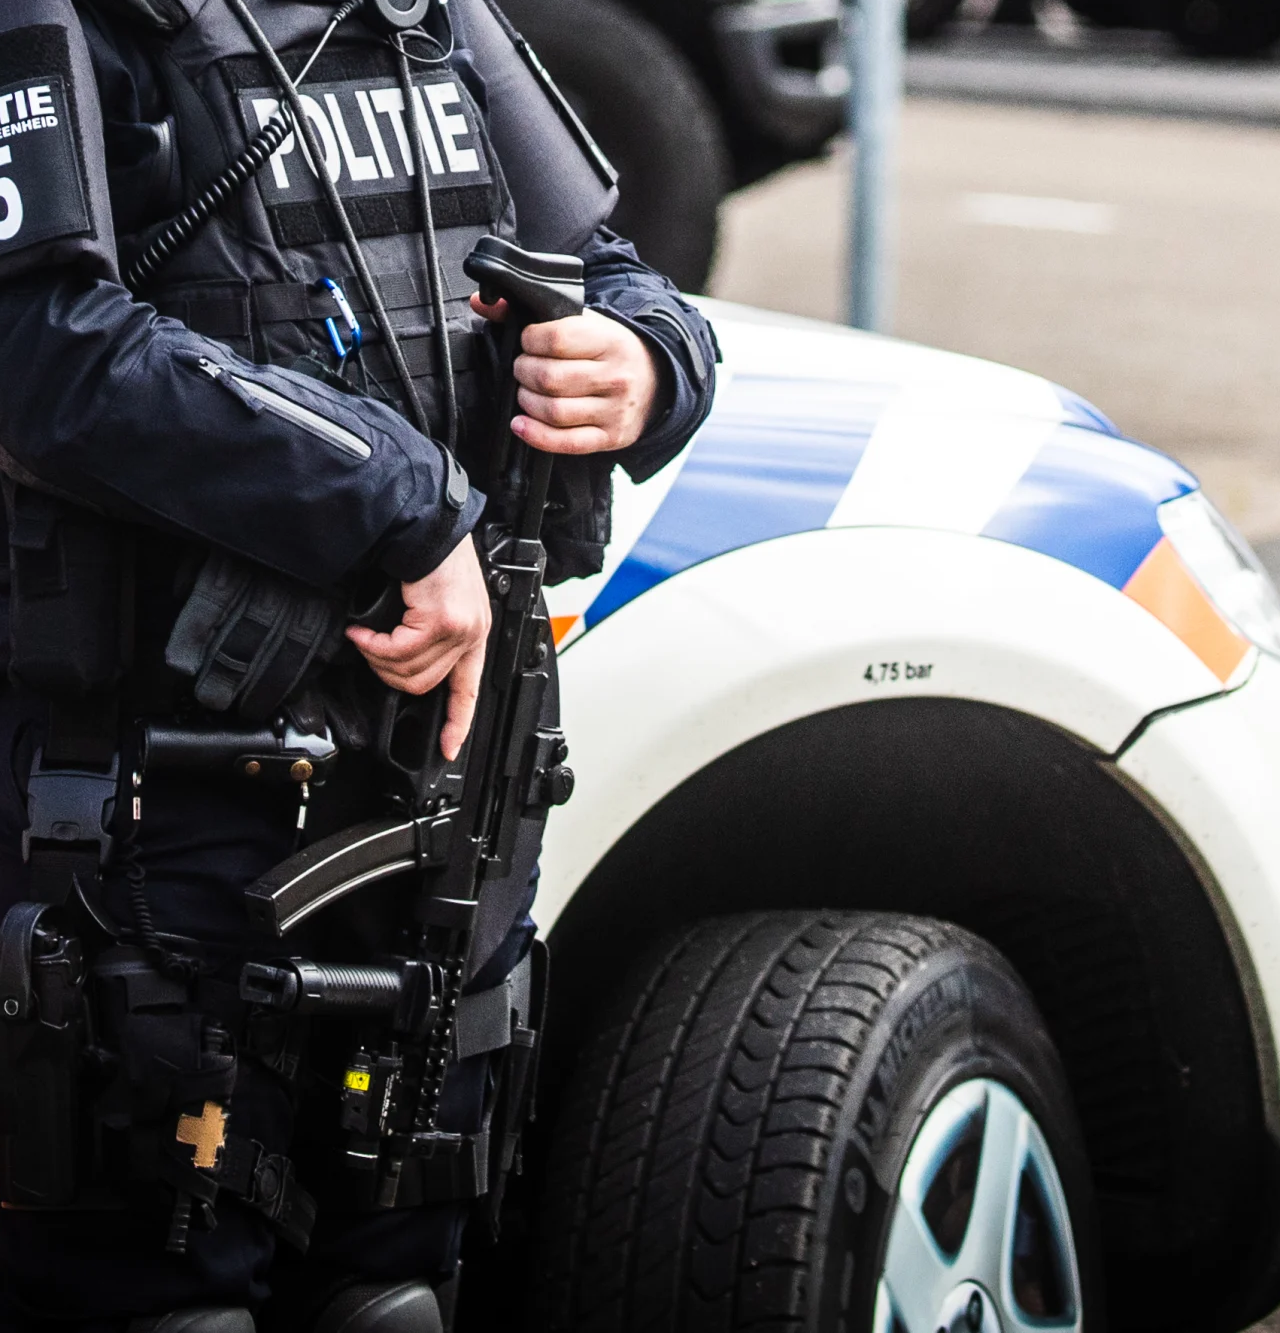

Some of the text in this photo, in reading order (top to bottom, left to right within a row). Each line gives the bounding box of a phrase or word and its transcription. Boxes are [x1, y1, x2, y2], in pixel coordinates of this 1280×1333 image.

[251, 80, 480, 189] POLITIE
[863, 661, 933, 684] 4,75 bar
